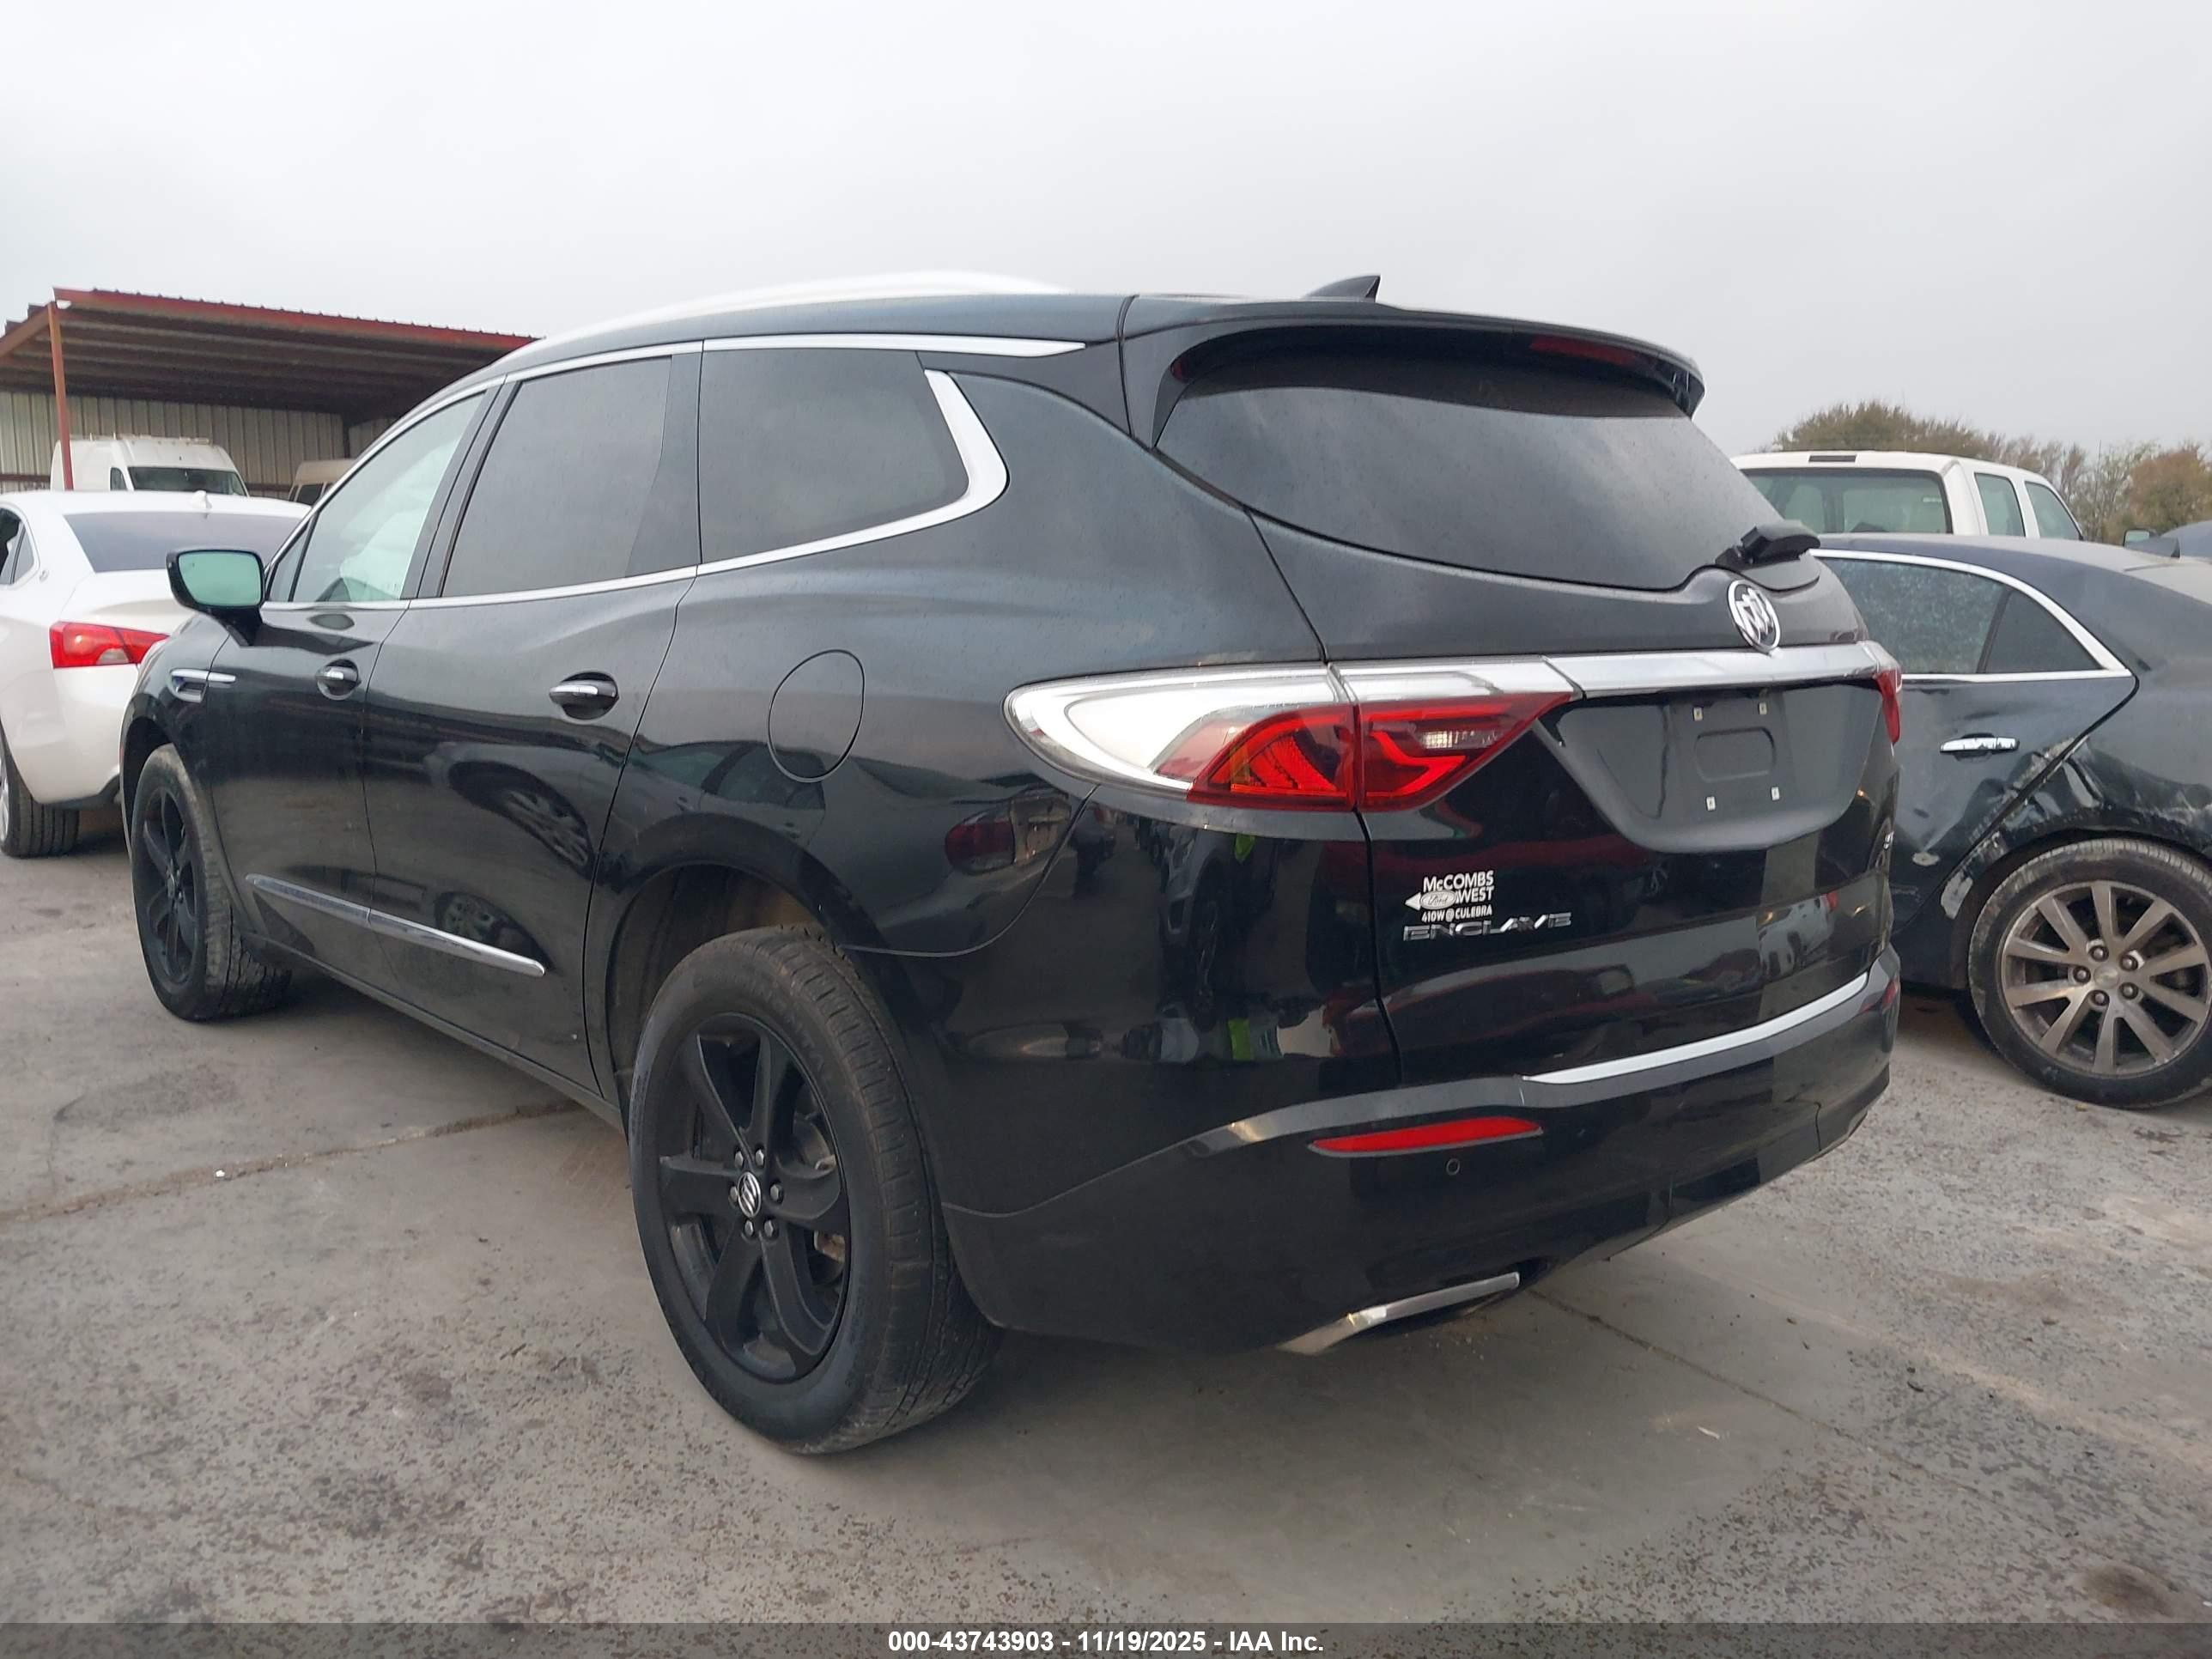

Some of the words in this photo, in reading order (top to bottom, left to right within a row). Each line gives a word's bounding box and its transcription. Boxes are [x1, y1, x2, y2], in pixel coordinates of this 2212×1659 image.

[1423, 870, 1494, 893] McCOMBS
[1459, 885, 1494, 903] WEST
[1403, 912, 1571, 941] ENCLAVE
